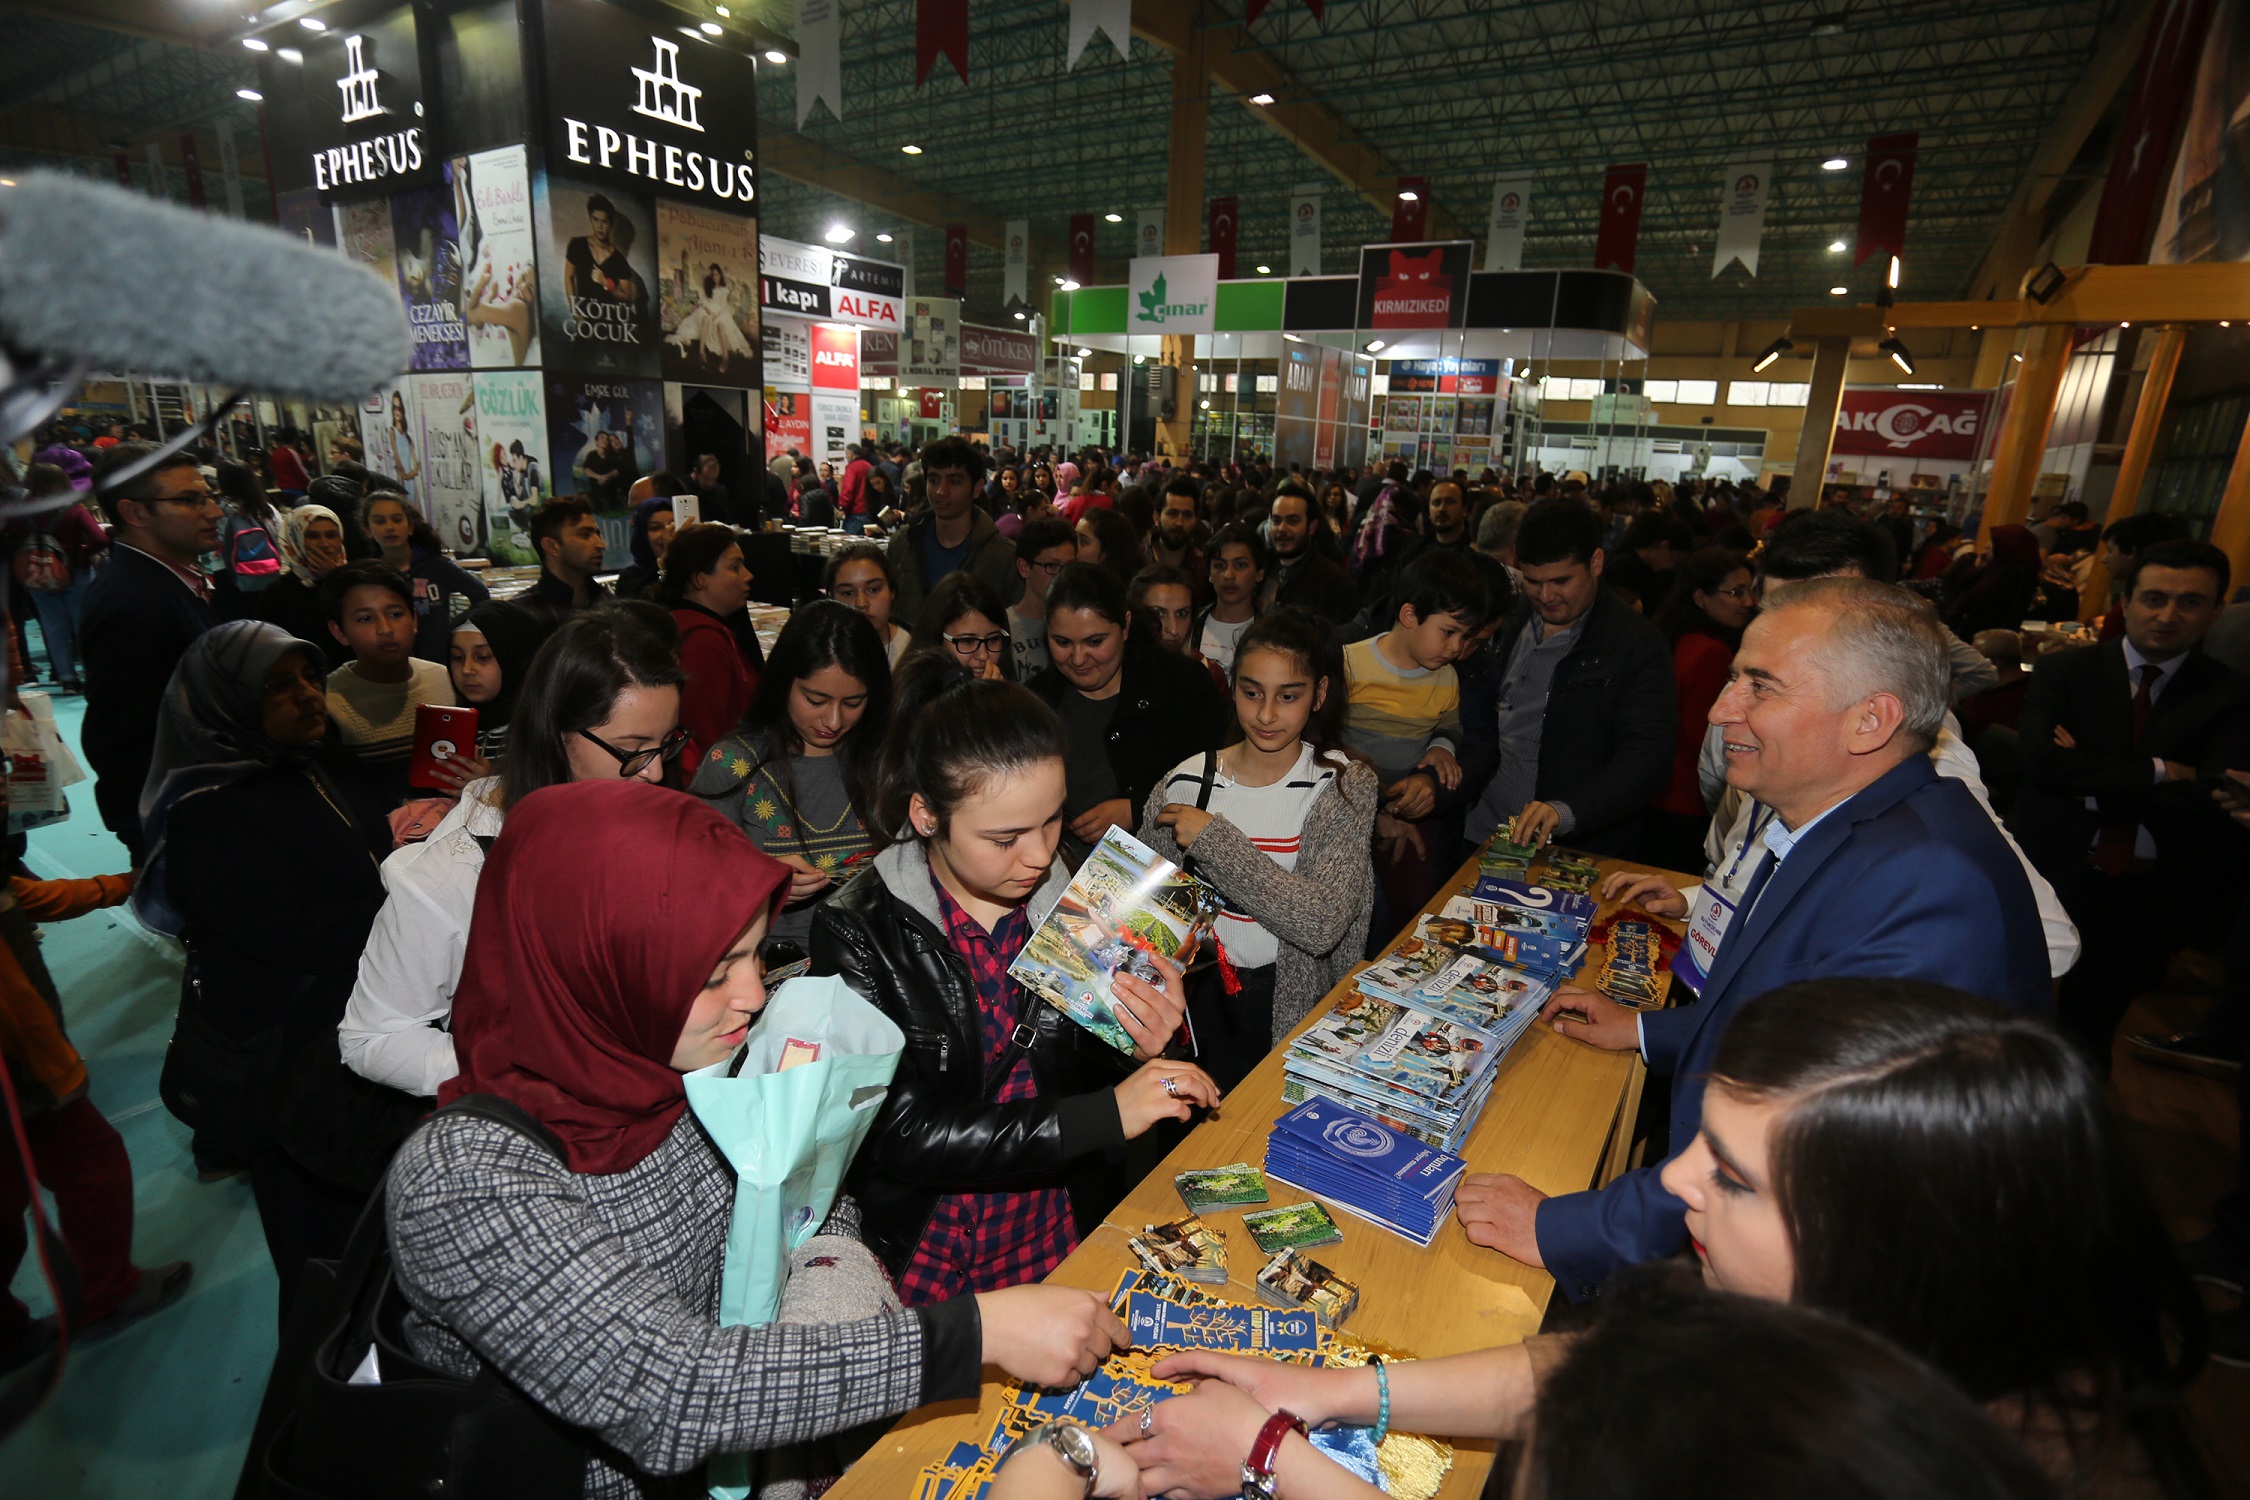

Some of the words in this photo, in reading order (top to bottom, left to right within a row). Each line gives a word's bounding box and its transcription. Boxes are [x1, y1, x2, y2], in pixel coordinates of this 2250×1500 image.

[313, 128, 422, 191] EPHESUS
[563, 117, 755, 202] EPHESUS
[769, 252, 824, 276] EVEREST
[568, 295, 631, 323] KÖTÜ
[775, 281, 818, 312] kapı
[838, 295, 896, 322] ALFA
[1374, 295, 1450, 314] KIRMIZIKEDİ
[410, 299, 458, 324] CEZAYİR
[1153, 303, 1208, 322] çınar
[562, 319, 641, 344] ÇOCUK
[815, 350, 854, 368] ALFA
[981, 336, 1033, 360] ÖTÜKEN
[1286, 362, 1314, 393] ADAM
[479, 380, 541, 417] GÖZLÜK
[1836, 404, 1978, 448] AKÇAĞ
[1690, 928, 1716, 957] GÖREVL
[1428, 969, 1461, 994] denizli
[1373, 1027, 1411, 1058] denizli
[1420, 1154, 1455, 1177] bunları
